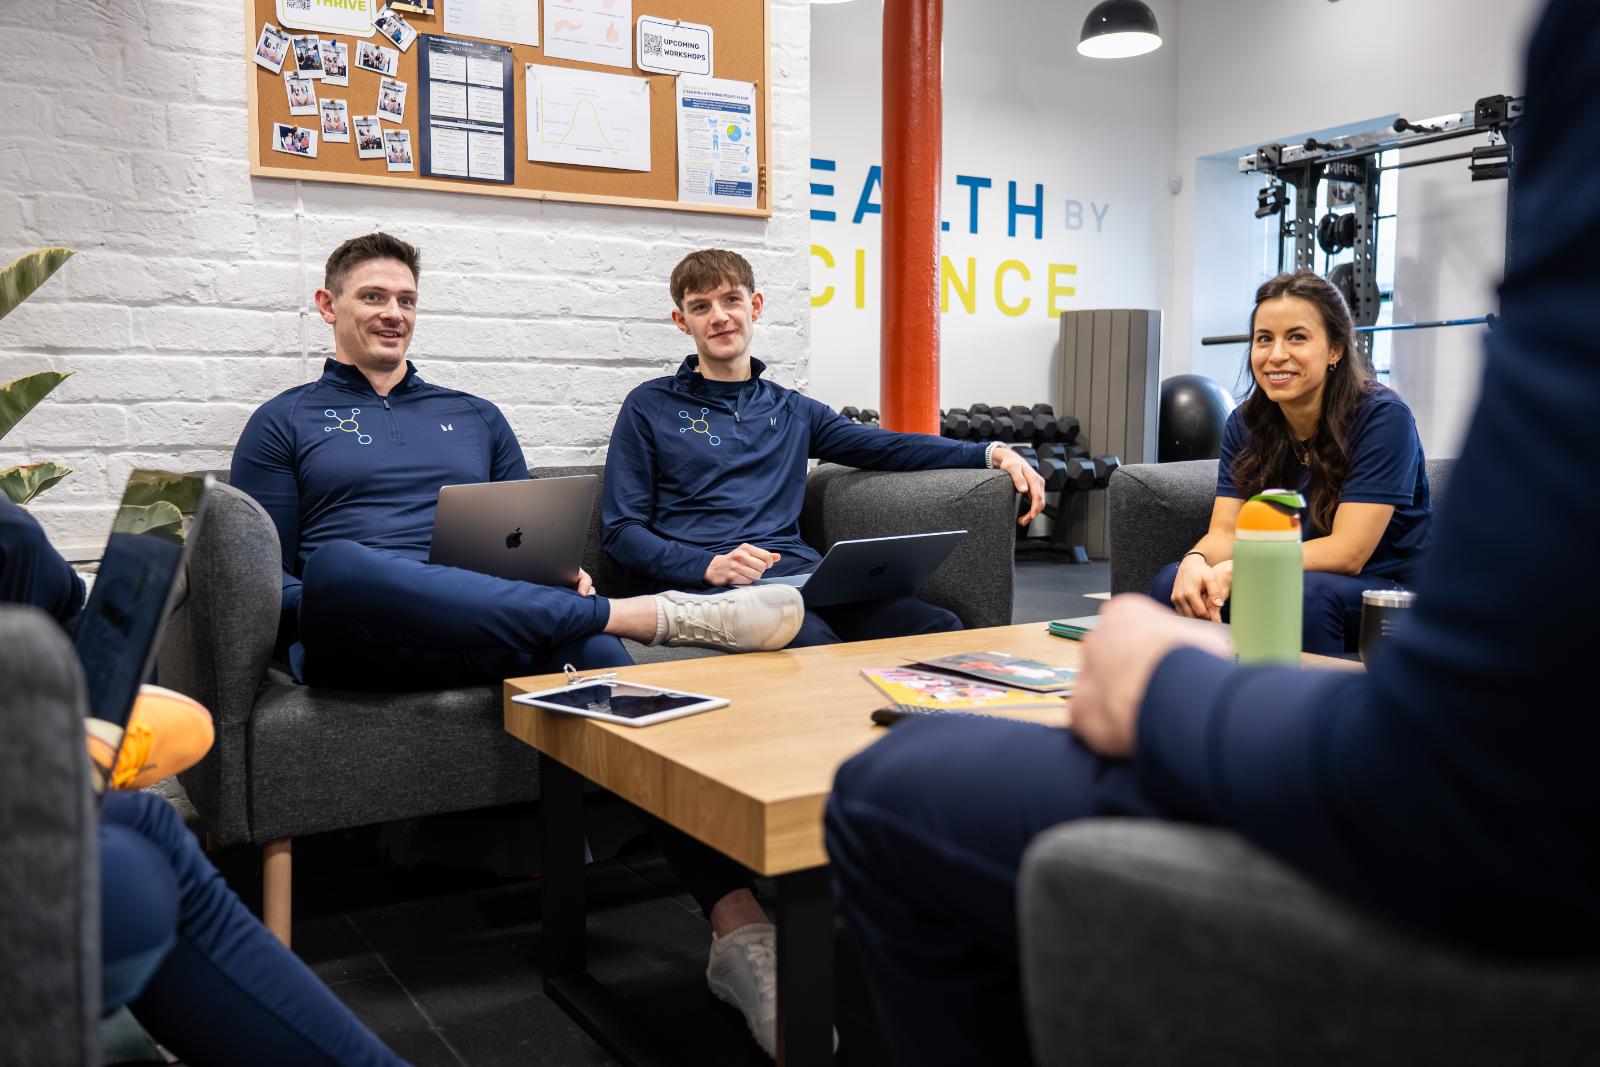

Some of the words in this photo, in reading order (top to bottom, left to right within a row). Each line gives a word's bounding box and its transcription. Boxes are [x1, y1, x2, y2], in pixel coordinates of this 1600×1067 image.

[663, 38, 700, 49] UPCOMING
[663, 49, 706, 61] WORKSHOPS
[810, 157, 1044, 240] EATH
[1064, 199, 1110, 233] BY
[810, 244, 1078, 319] CINCE
